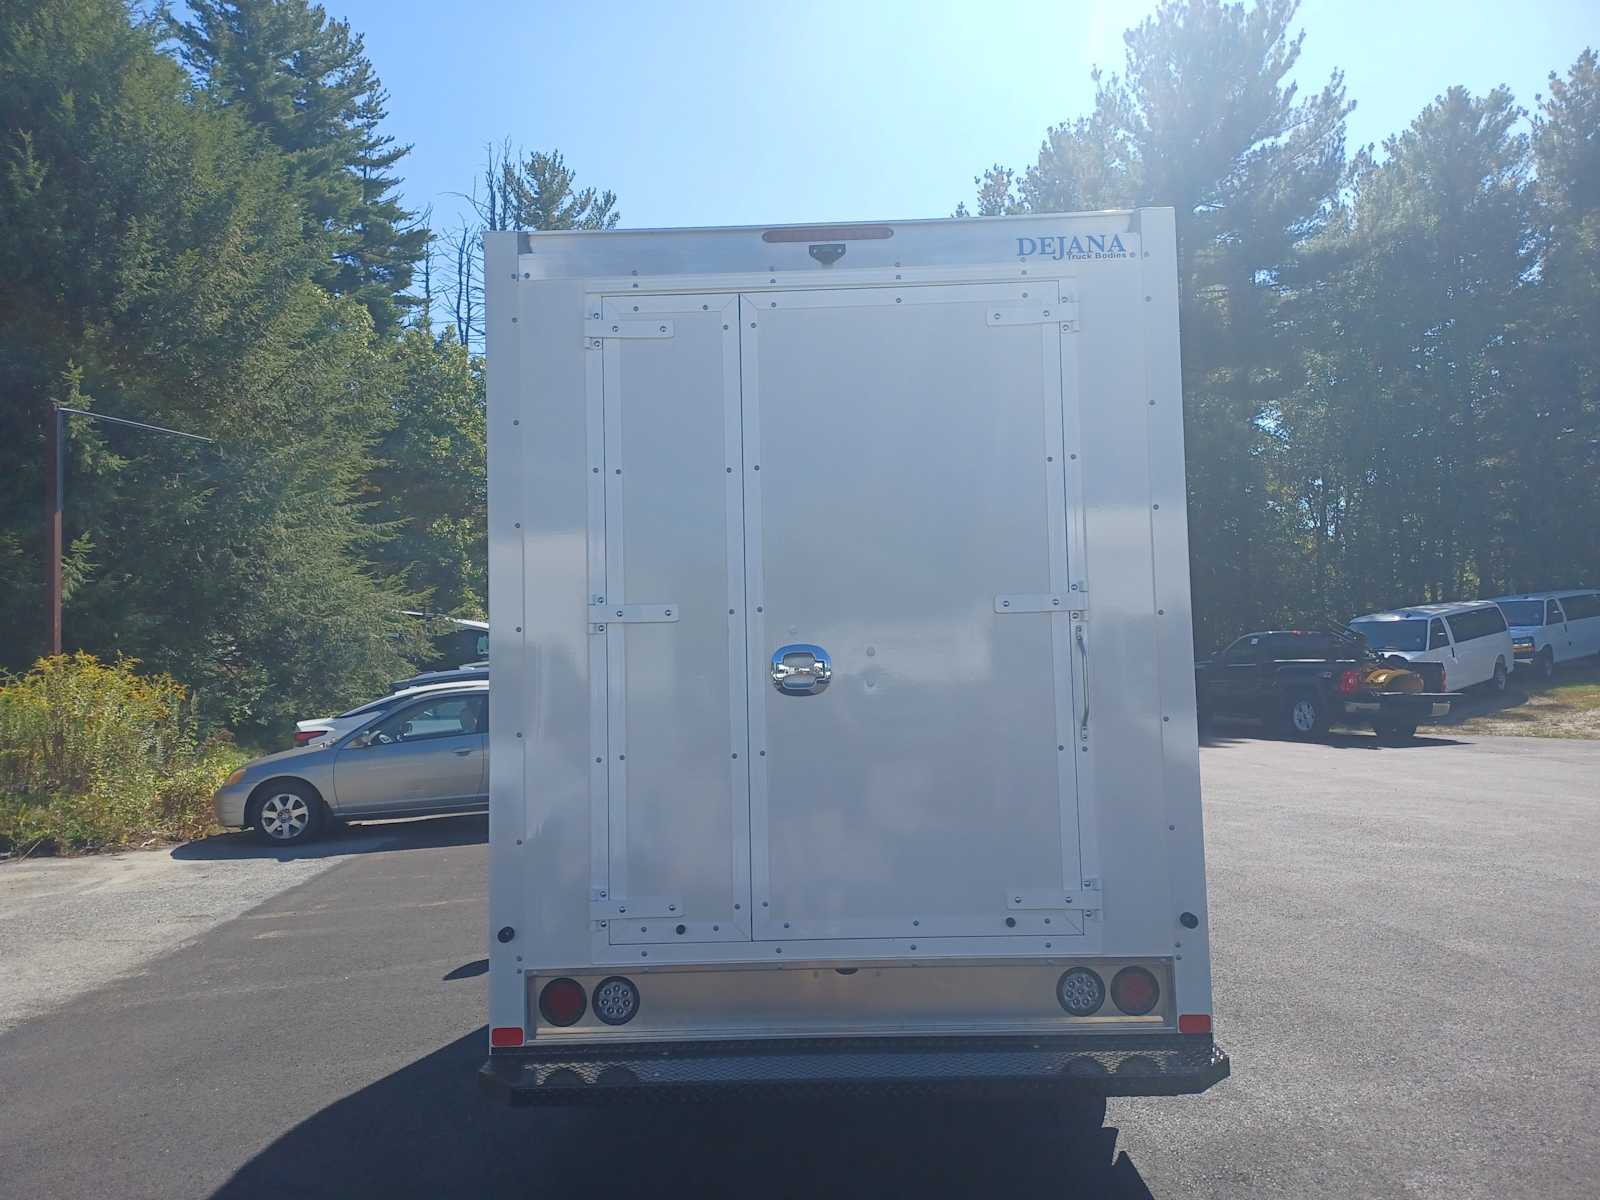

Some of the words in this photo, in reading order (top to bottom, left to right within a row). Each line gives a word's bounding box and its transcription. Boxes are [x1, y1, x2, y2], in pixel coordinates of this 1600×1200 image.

[1016, 234, 1126, 260] DEJANA
[1067, 251, 1092, 260] Truck
[1095, 251, 1127, 260] Bodies
